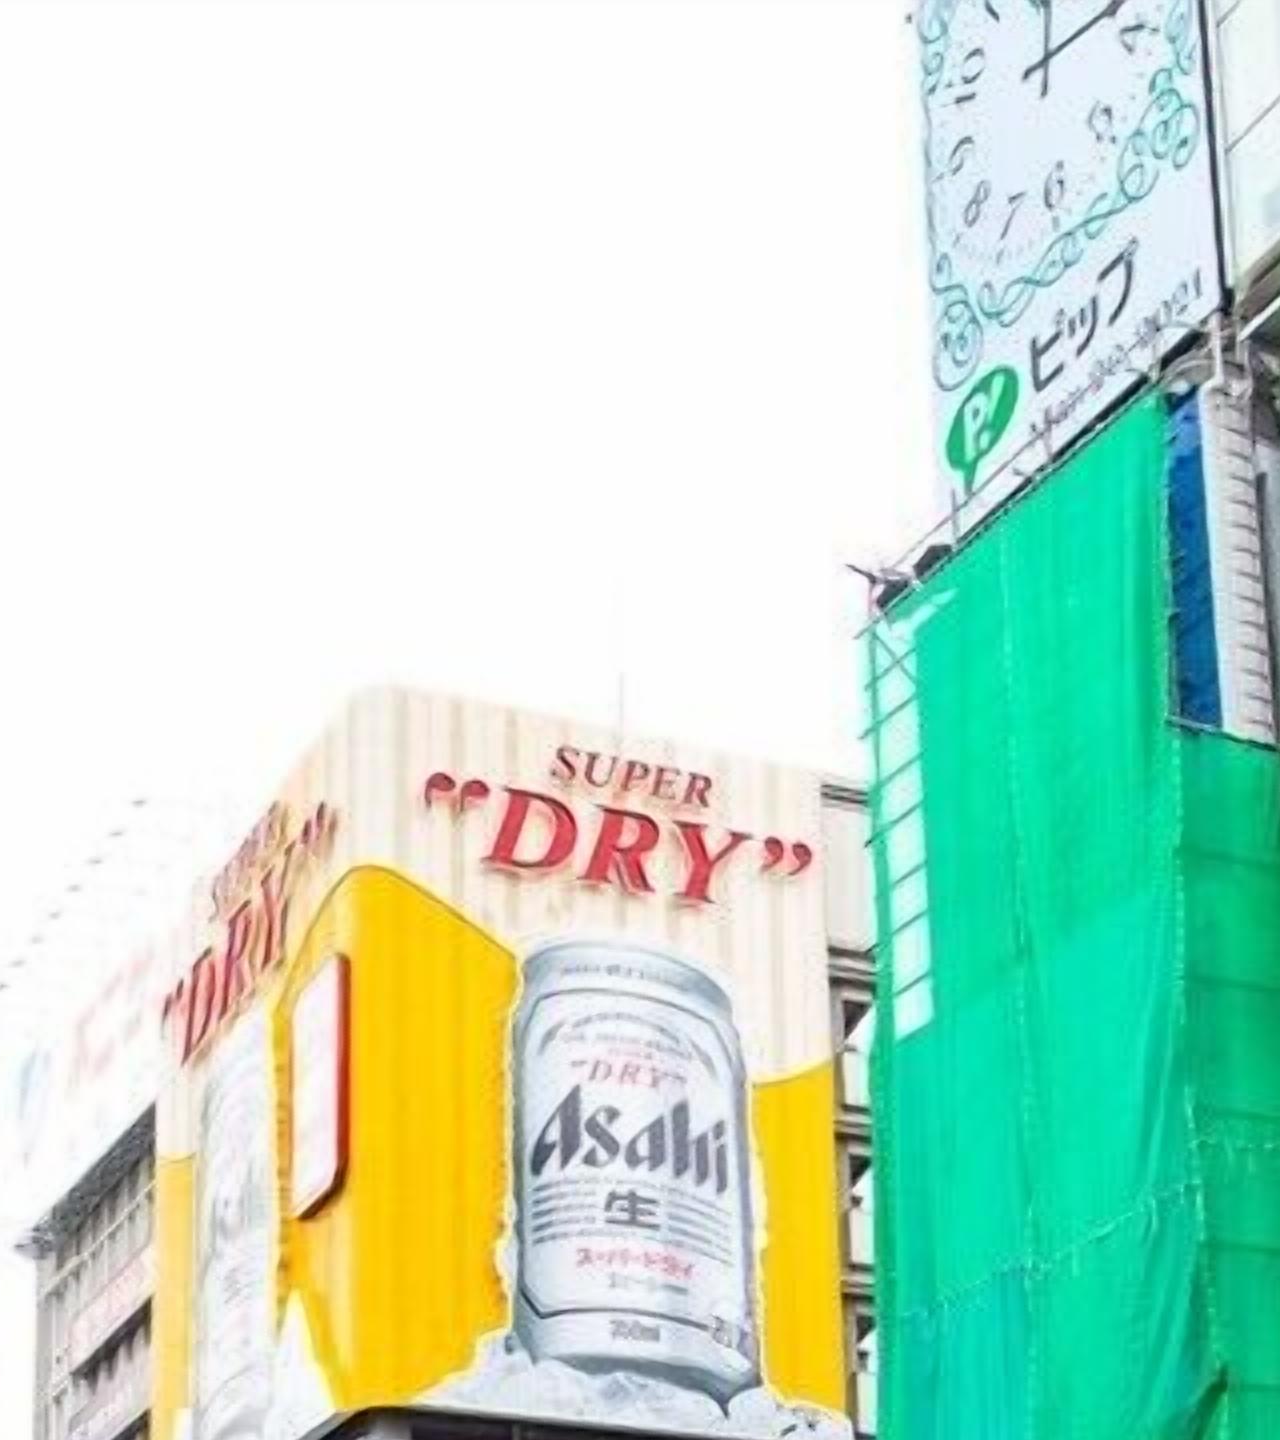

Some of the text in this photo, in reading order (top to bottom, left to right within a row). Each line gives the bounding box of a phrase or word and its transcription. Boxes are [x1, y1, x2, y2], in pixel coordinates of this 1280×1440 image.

[549, 744, 716, 809] SUPER
[530, 1084, 728, 1196] Asahi
[604, 1188, 661, 1232] 生
